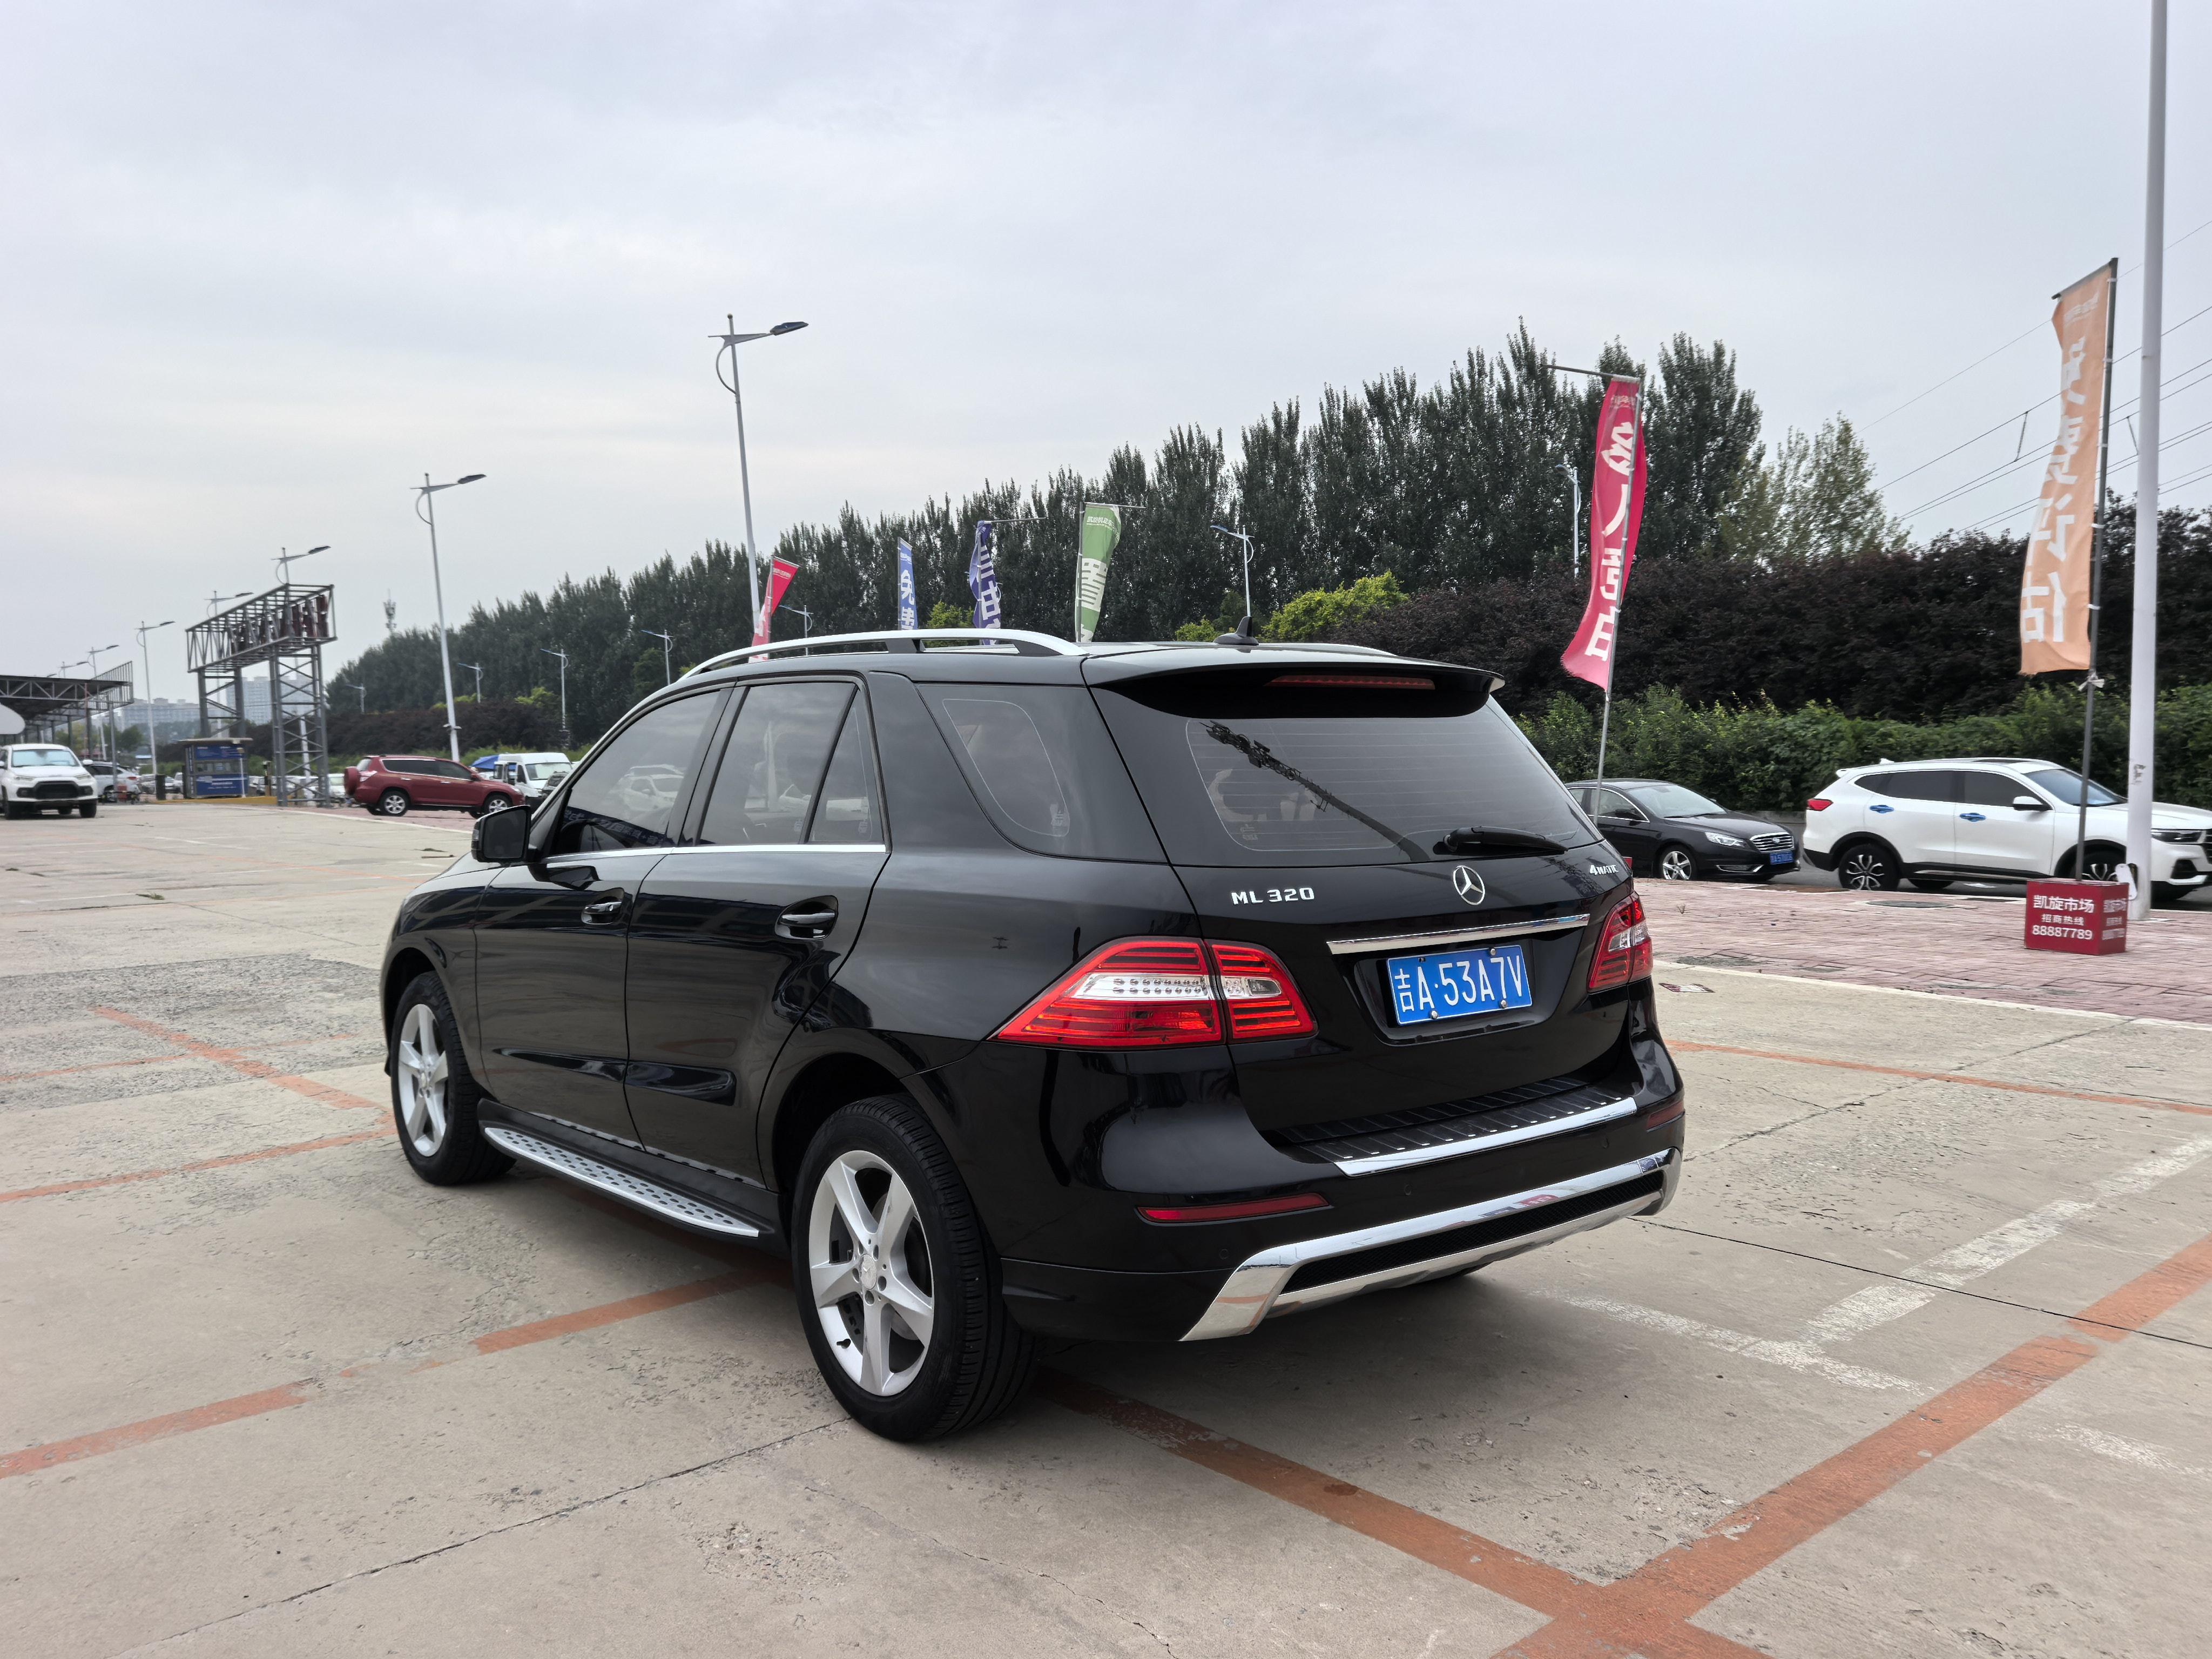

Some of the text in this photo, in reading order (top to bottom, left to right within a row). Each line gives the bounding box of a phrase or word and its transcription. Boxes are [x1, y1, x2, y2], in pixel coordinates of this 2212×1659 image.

[1231, 888, 1314, 905] ML 320
[2033, 895, 2094, 913] 凯旋市场
[2041, 914, 2084, 926] 招商热线
[2032, 925, 2093, 940] 88887789
